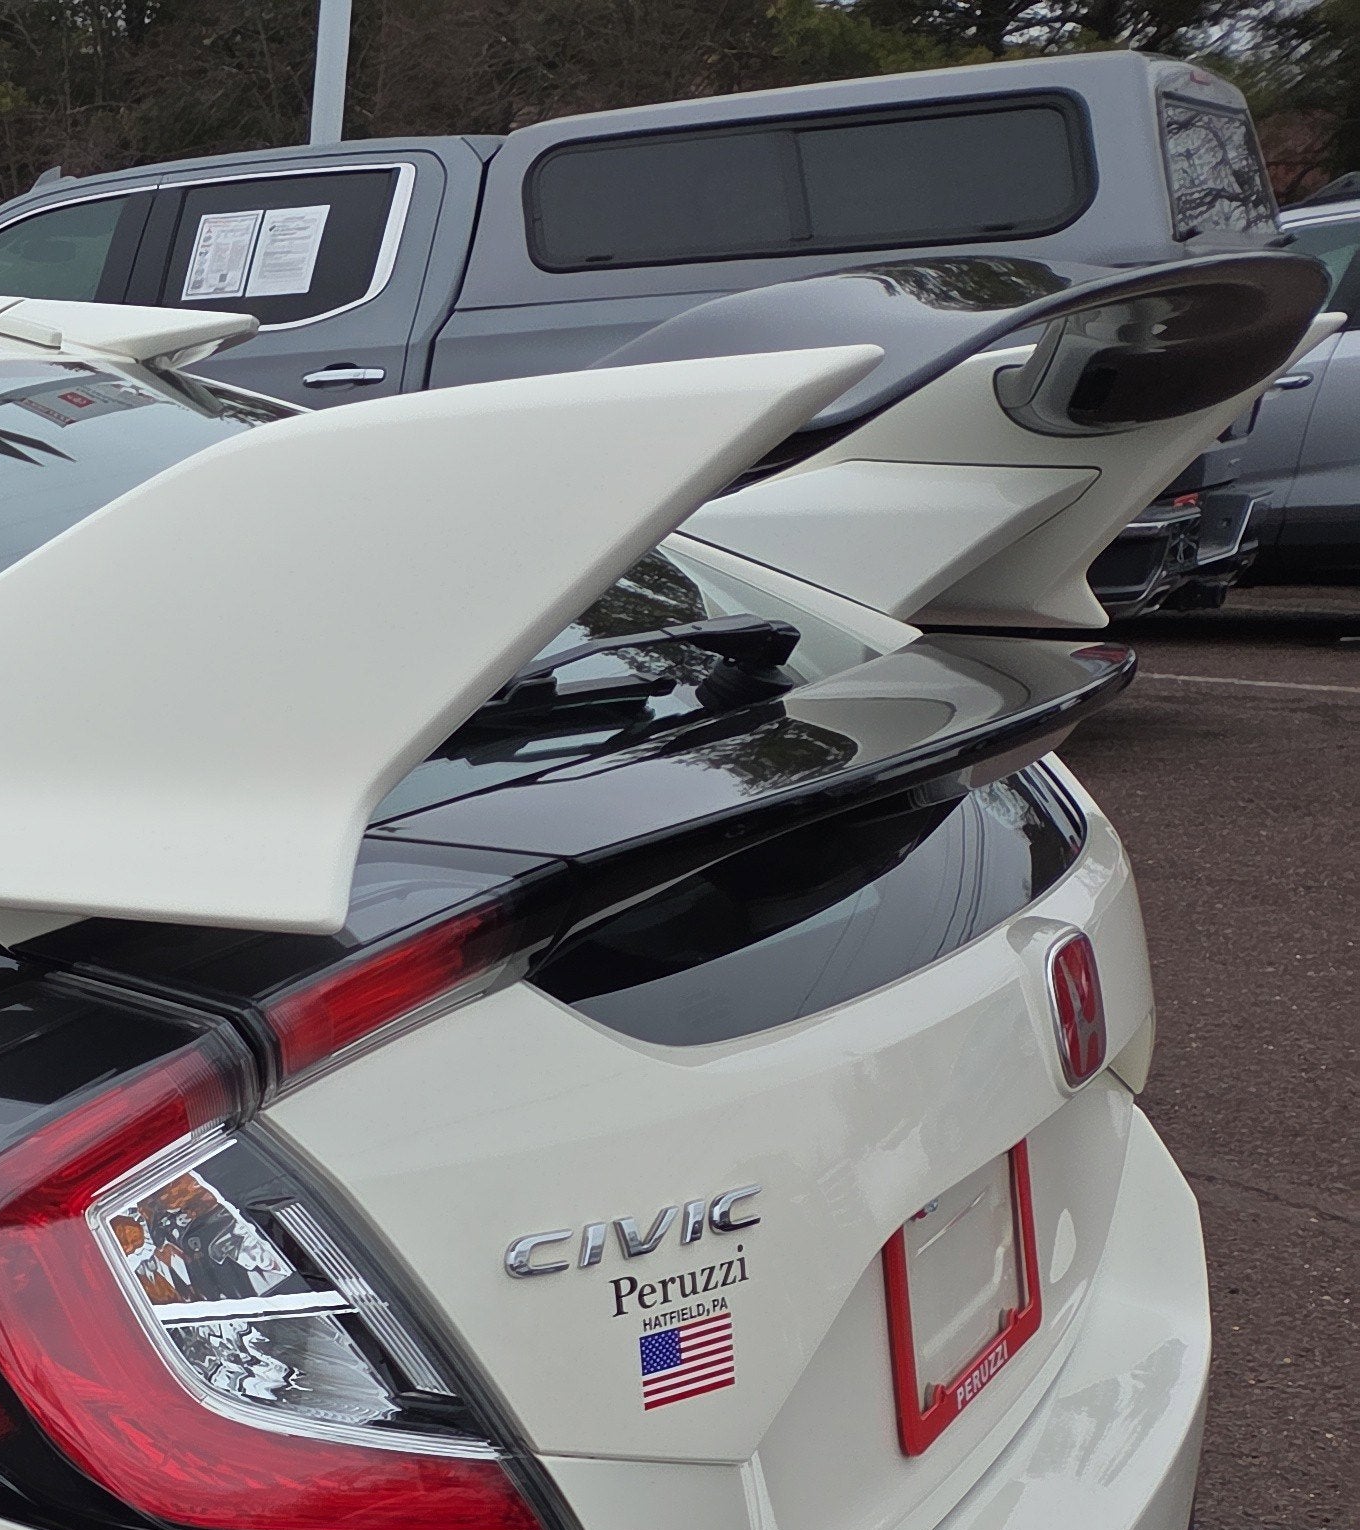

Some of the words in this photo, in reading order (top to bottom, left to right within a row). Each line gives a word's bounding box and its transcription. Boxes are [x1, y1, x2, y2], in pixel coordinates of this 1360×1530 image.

[504, 1183, 763, 1279] CIVIC
[609, 1244, 749, 1317] Peruzzi
[956, 1339, 1008, 1410] PERUZZI
